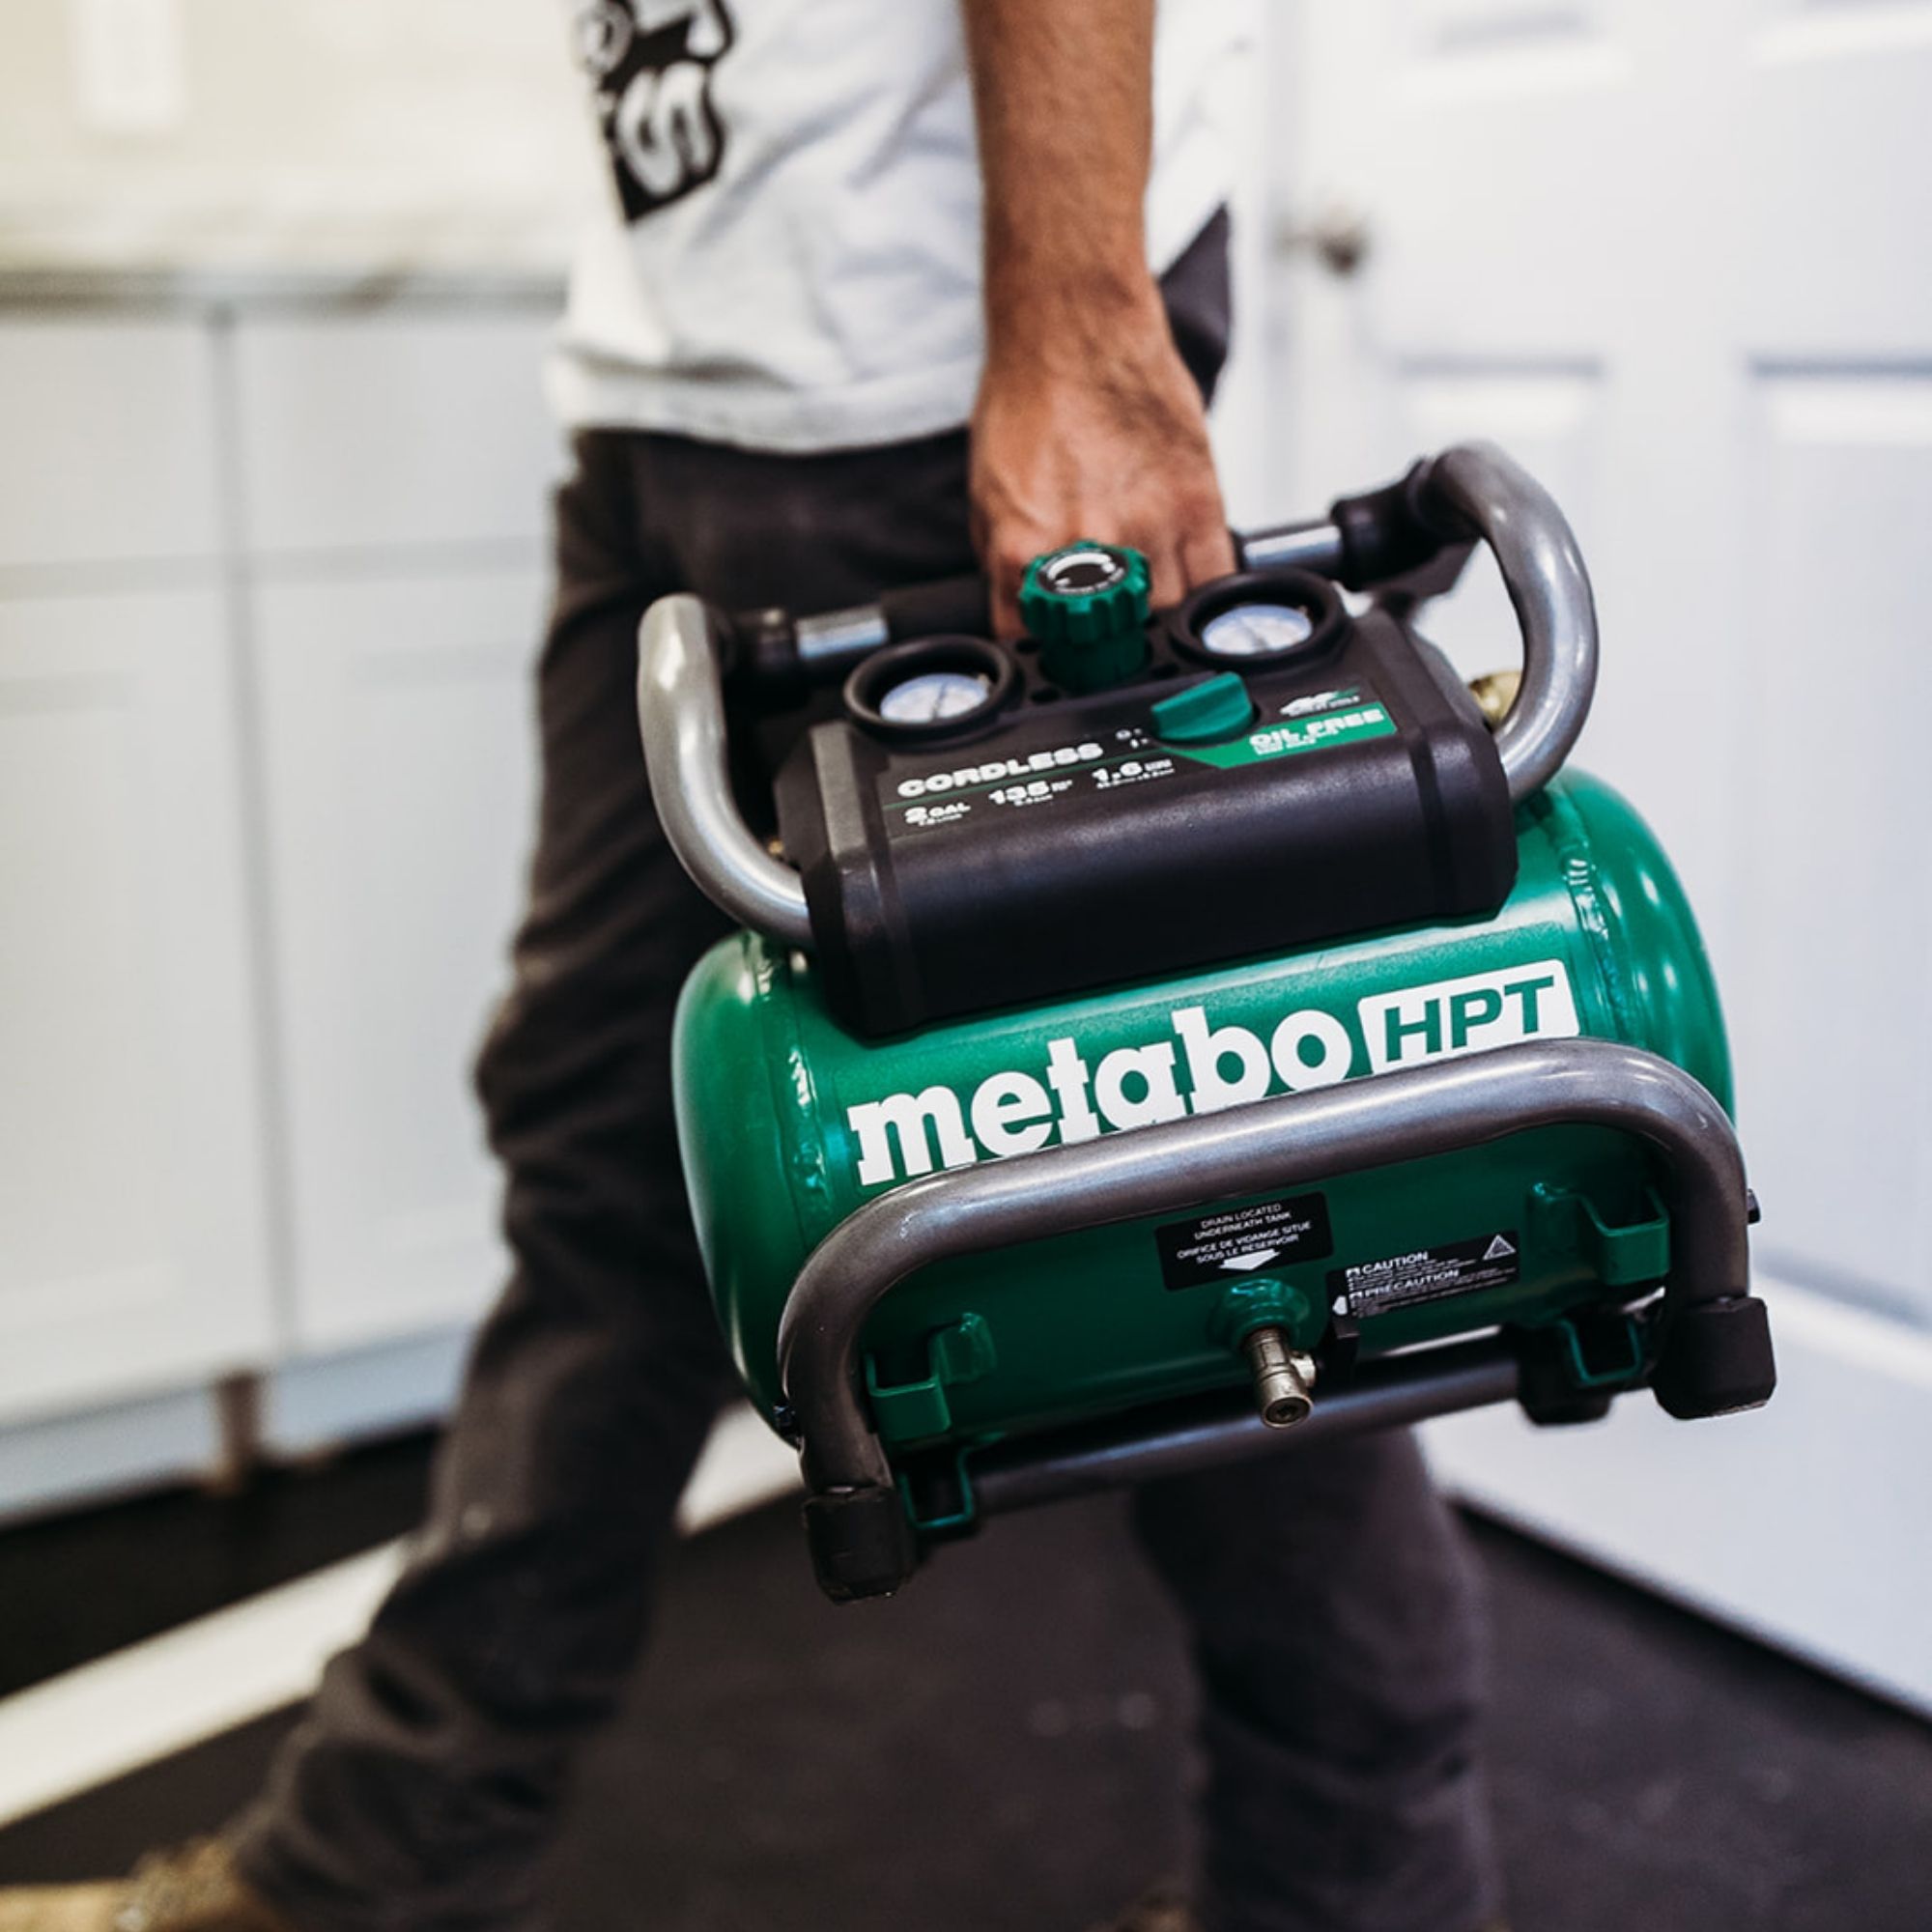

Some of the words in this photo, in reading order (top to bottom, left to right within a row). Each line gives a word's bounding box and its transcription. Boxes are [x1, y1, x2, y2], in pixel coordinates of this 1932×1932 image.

[1305, 708, 1385, 736] FREE
[897, 743, 1103, 797] CORDLESS
[847, 1006, 1352, 1186] metabo
[1384, 976, 1553, 1063] HPT
[1194, 1218, 1263, 1239] UNDERNEATH
[1264, 1211, 1292, 1224] TANK
[1201, 1214, 1234, 1229] DRAIN
[1235, 1203, 1283, 1222] LOCATED
[1177, 1241, 1217, 1260] ORIFICE
[1219, 1238, 1234, 1249] DE
[1236, 1228, 1280, 1245] VIDANGE
[1196, 1251, 1225, 1264] SOUS
[1226, 1246, 1238, 1257] LE
[1361, 1250, 1429, 1275] CAUTION
